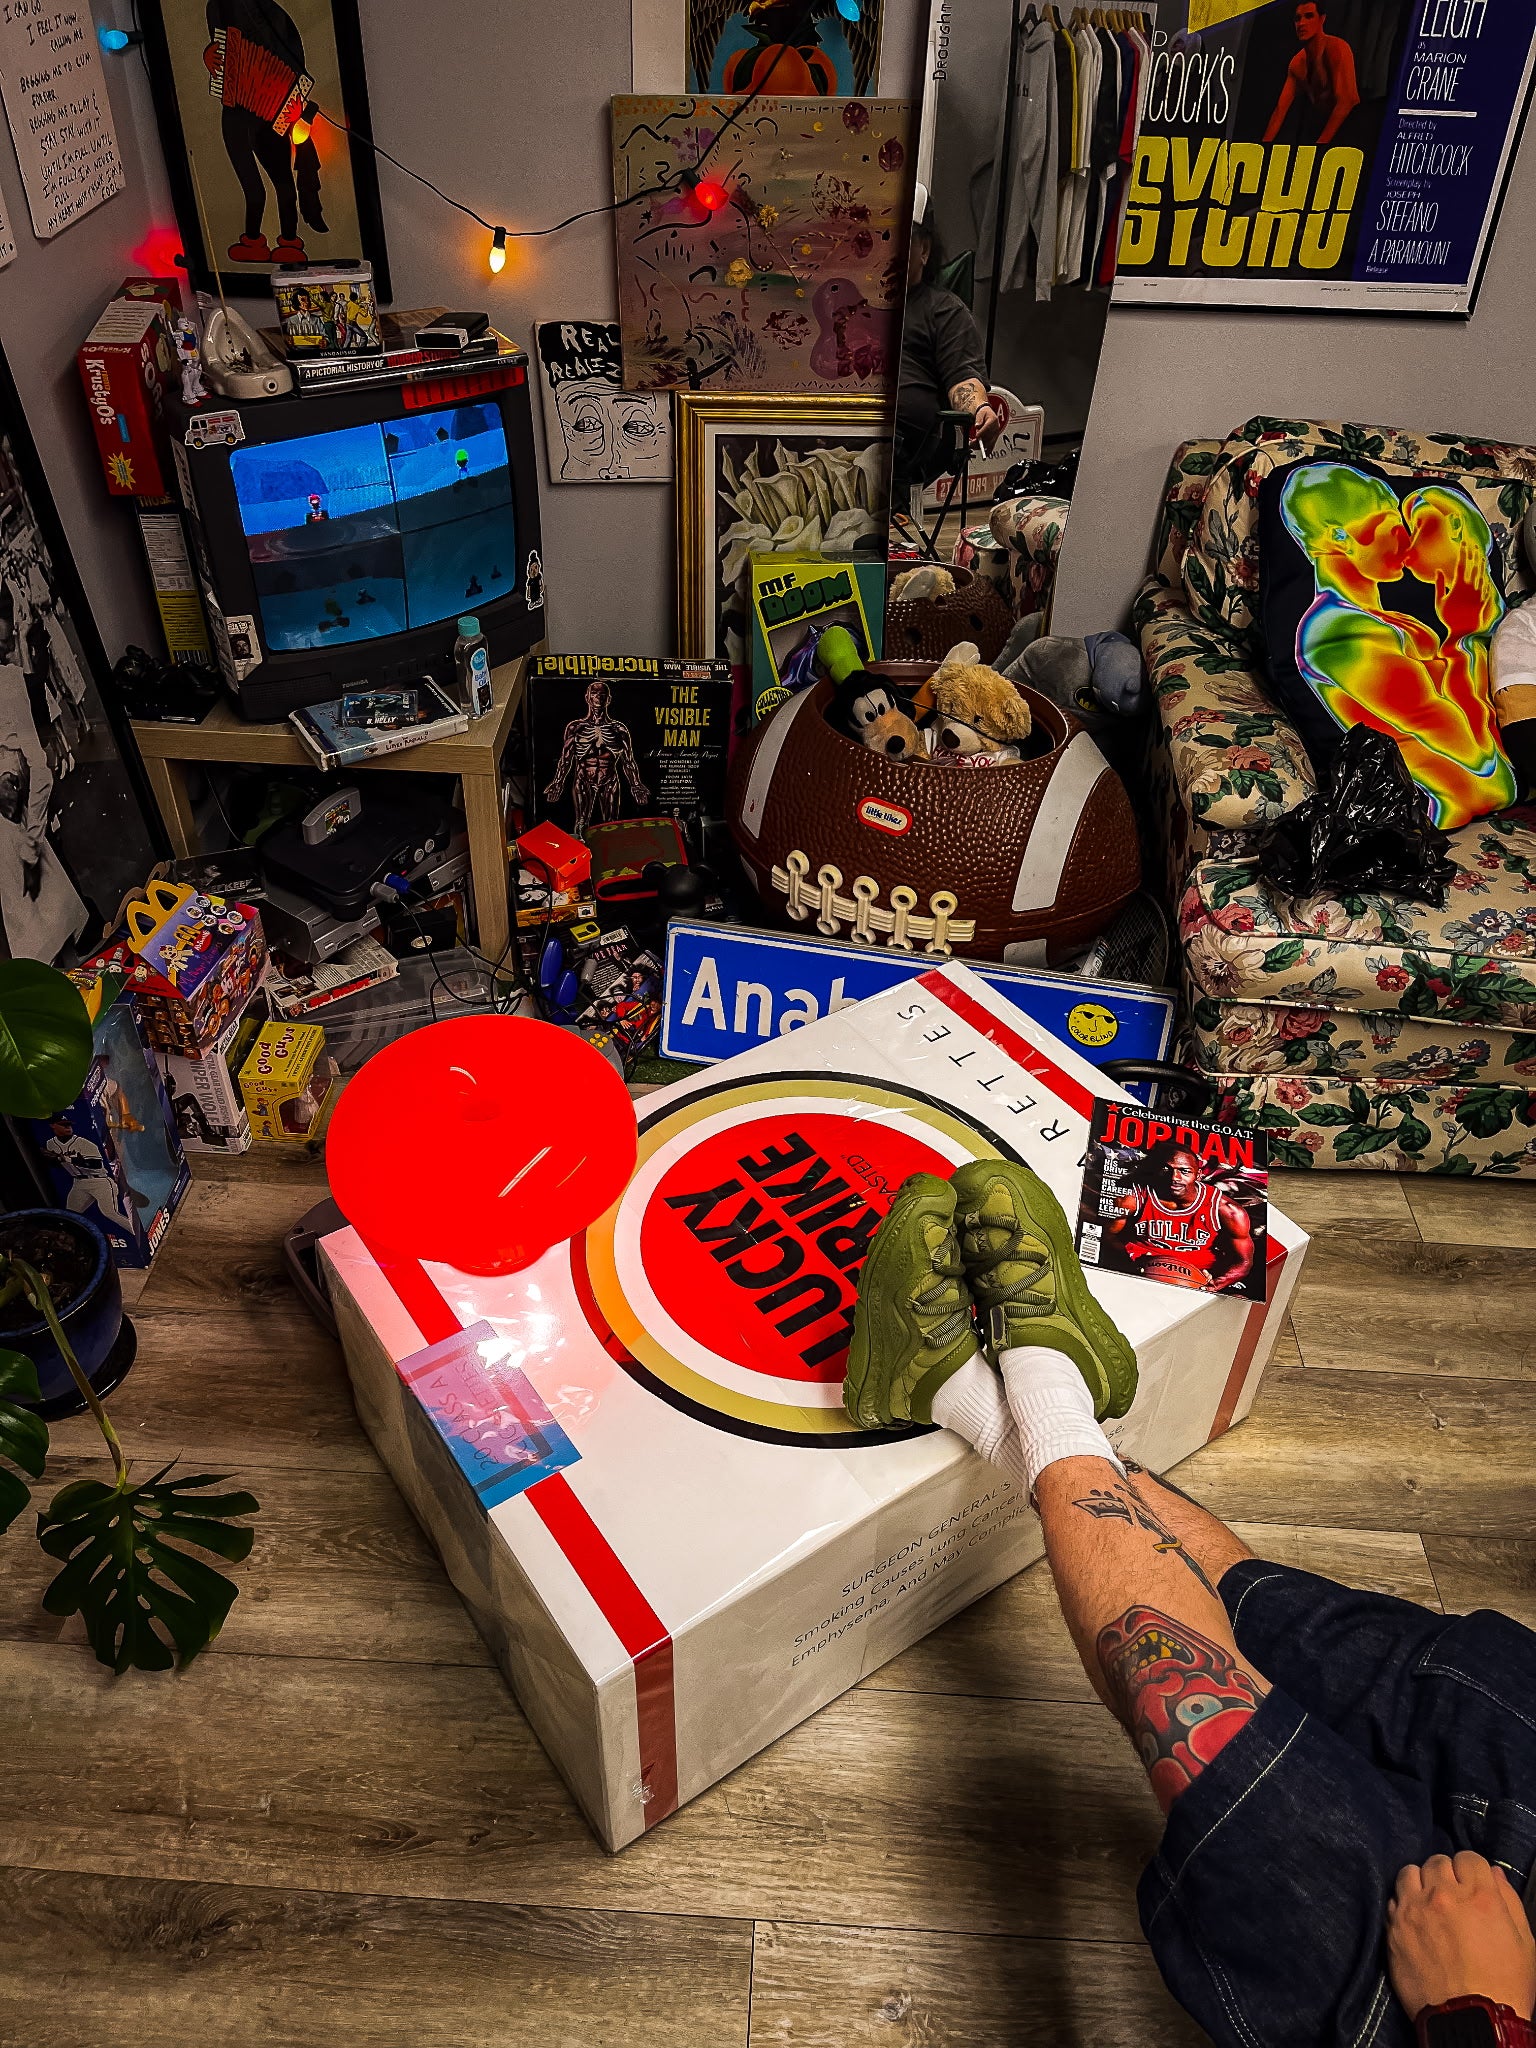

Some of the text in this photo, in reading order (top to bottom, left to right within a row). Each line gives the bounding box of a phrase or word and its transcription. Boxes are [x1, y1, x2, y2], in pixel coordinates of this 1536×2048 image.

[27, 24, 35, 46] I
[1414, 52, 1467, 63] MARION
[1142, 47, 1235, 124] COCK'S
[1407, 66, 1463, 101] CRANE
[1399, 119, 1437, 131] Directed by
[1397, 132, 1434, 141] ALFRED
[94, 150, 115, 171] NEVER
[1389, 143, 1474, 175] HITCHCOCK
[1118, 136, 1364, 269] SYCHO
[1386, 191, 1421, 199] JOSEPH
[1376, 200, 1439, 232] STEFANO
[1368, 239, 1451, 265] A PARAMOUNT
[1366, 265, 1389, 274] Release
[561, 325, 620, 352] REAL
[305, 369, 312, 379] A
[311, 364, 347, 378] PICTORIAL
[346, 360, 374, 373] HISTORY
[373, 359, 384, 369] OF
[758, 572, 797, 597] MF
[759, 571, 853, 627] DOOM
[474, 670, 487, 682] Baby
[537, 656, 659, 676] incredible!
[342, 679, 369, 689] TOSHIBA
[478, 677, 488, 687] Oil
[671, 685, 699, 704] THE
[654, 707, 711, 726] VISIBLE
[663, 729, 700, 747] MAN
[865, 805, 904, 825] little tikes
[274, 1026, 296, 1059] Guys
[1070, 1025, 1114, 1042] COLOR BLIND
[257, 1041, 273, 1075] Good
[243, 1080, 265, 1089] Good
[897, 1004, 1085, 1167] RETTES
[199, 1092, 220, 1124] WOLF
[1122, 1107, 1189, 1127] Celebrating
[1191, 1120, 1210, 1131] the
[1100, 1113, 1254, 1169] JORDAN
[1103, 1165, 1128, 1175] DRIVE
[1104, 1159, 1118, 1168] HIS
[1101, 1185, 1133, 1195] CAREER
[1102, 1178, 1116, 1187] HIS
[737, 1132, 883, 1290] RIKE
[1098, 1204, 1130, 1216] LEGACY
[1099, 1198, 1114, 1206] HIS
[149, 1208, 171, 1257] JONES
[1134, 1219, 1211, 1246] BULLS
[663, 1178, 858, 1369] LUCKY
[842, 1481, 1011, 1597] SURGEON GENERAL'S
[791, 1504, 1031, 1667] Emphysema, And May Complic
[793, 1594, 864, 1648] Smoking
[871, 1555, 924, 1595] Causes
[930, 1528, 967, 1558] Lung
